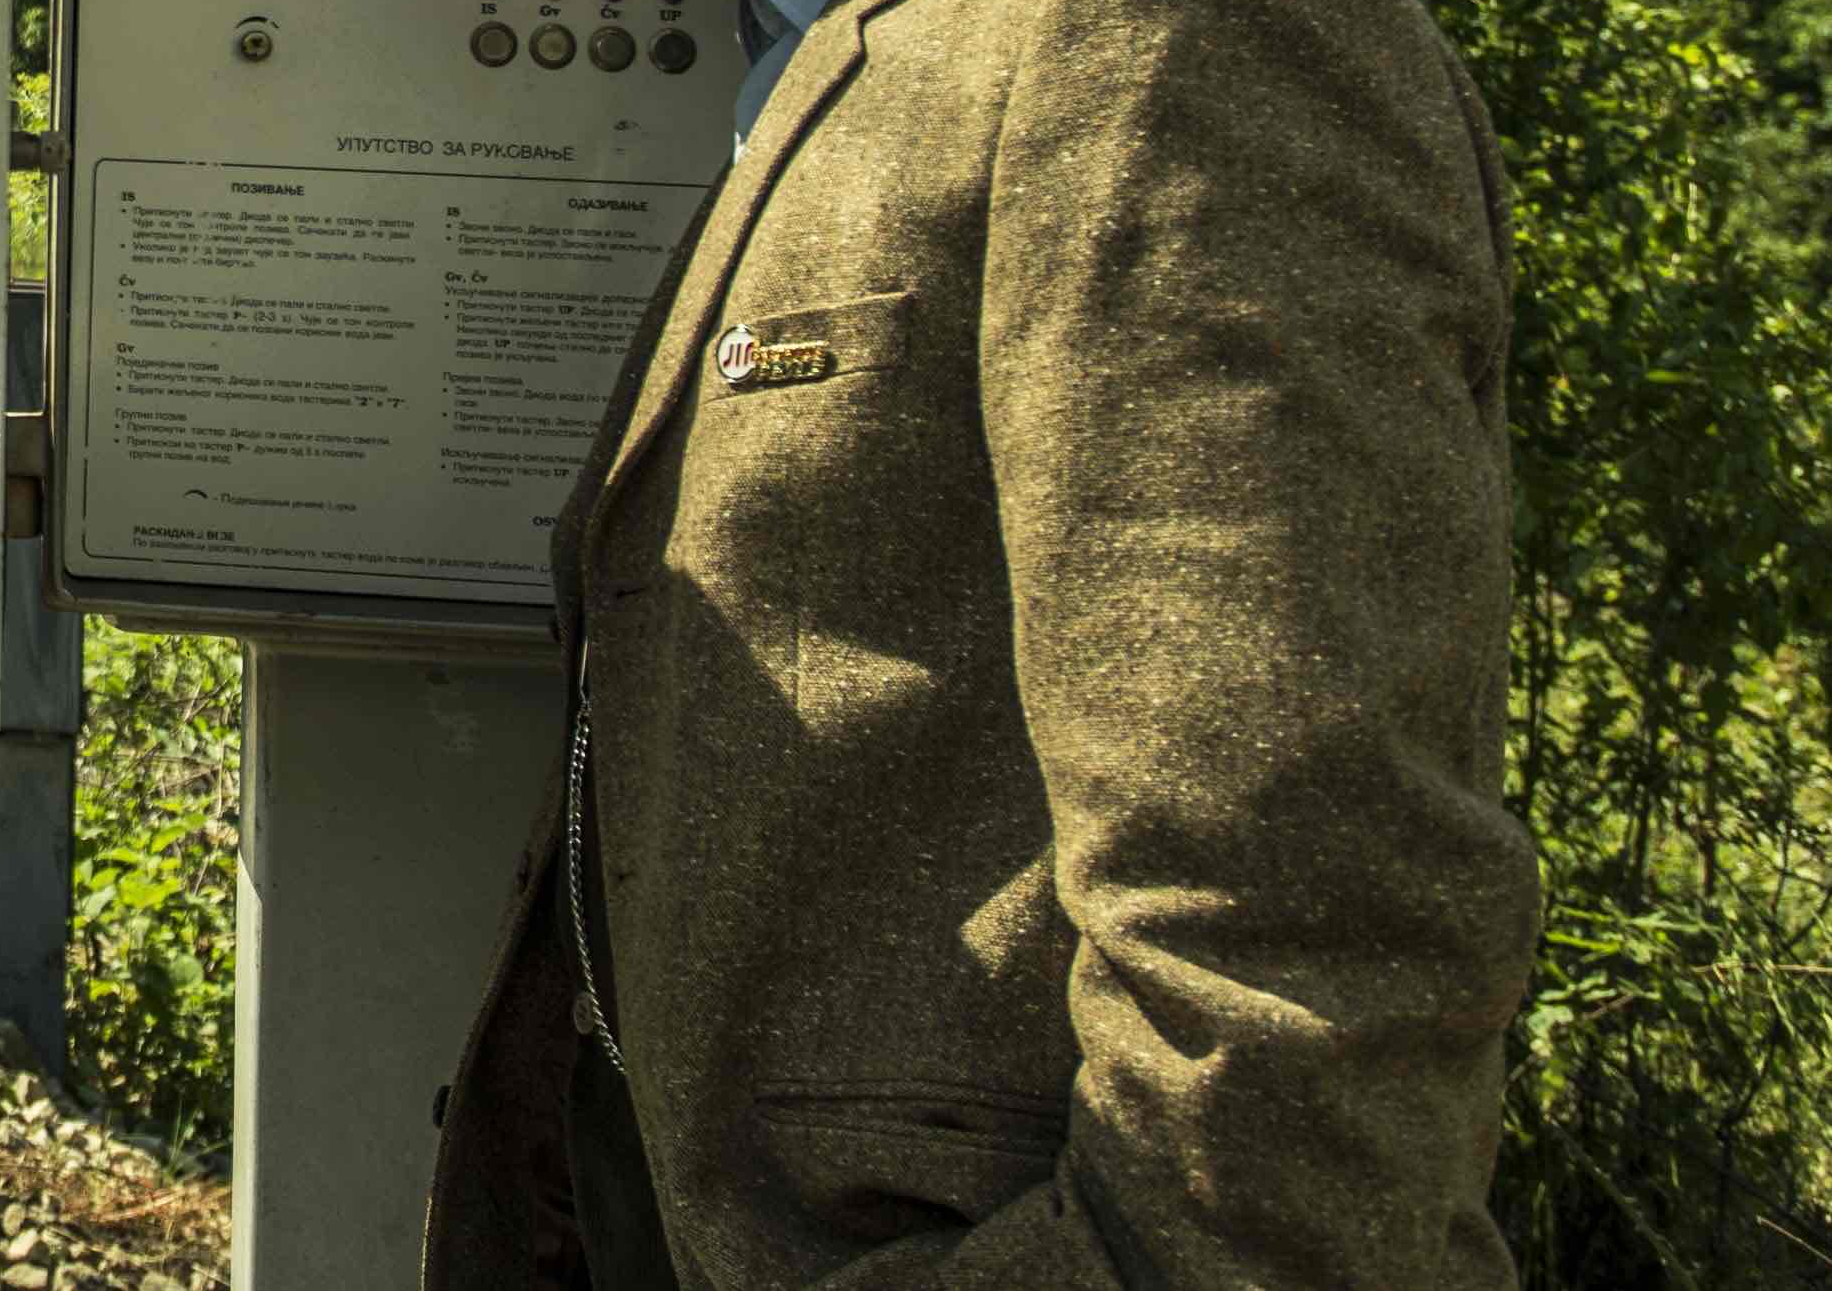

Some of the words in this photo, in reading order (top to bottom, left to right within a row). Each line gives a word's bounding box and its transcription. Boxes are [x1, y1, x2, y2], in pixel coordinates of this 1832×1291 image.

[481, 3, 498, 14] IS
[539, 5, 561, 17] Gv
[659, 9, 682, 21] UP
[336, 136, 433, 155] УПУТСТВО
[442, 140, 466, 157] ЗА
[470, 142, 576, 162] РУКОВАЊЕ
[231, 182, 306, 196] ПОЗИВАЊЕ
[121, 191, 136, 202] IS
[568, 198, 648, 212] ОДАЗИВАЊЕ
[117, 343, 136, 354] Gv
